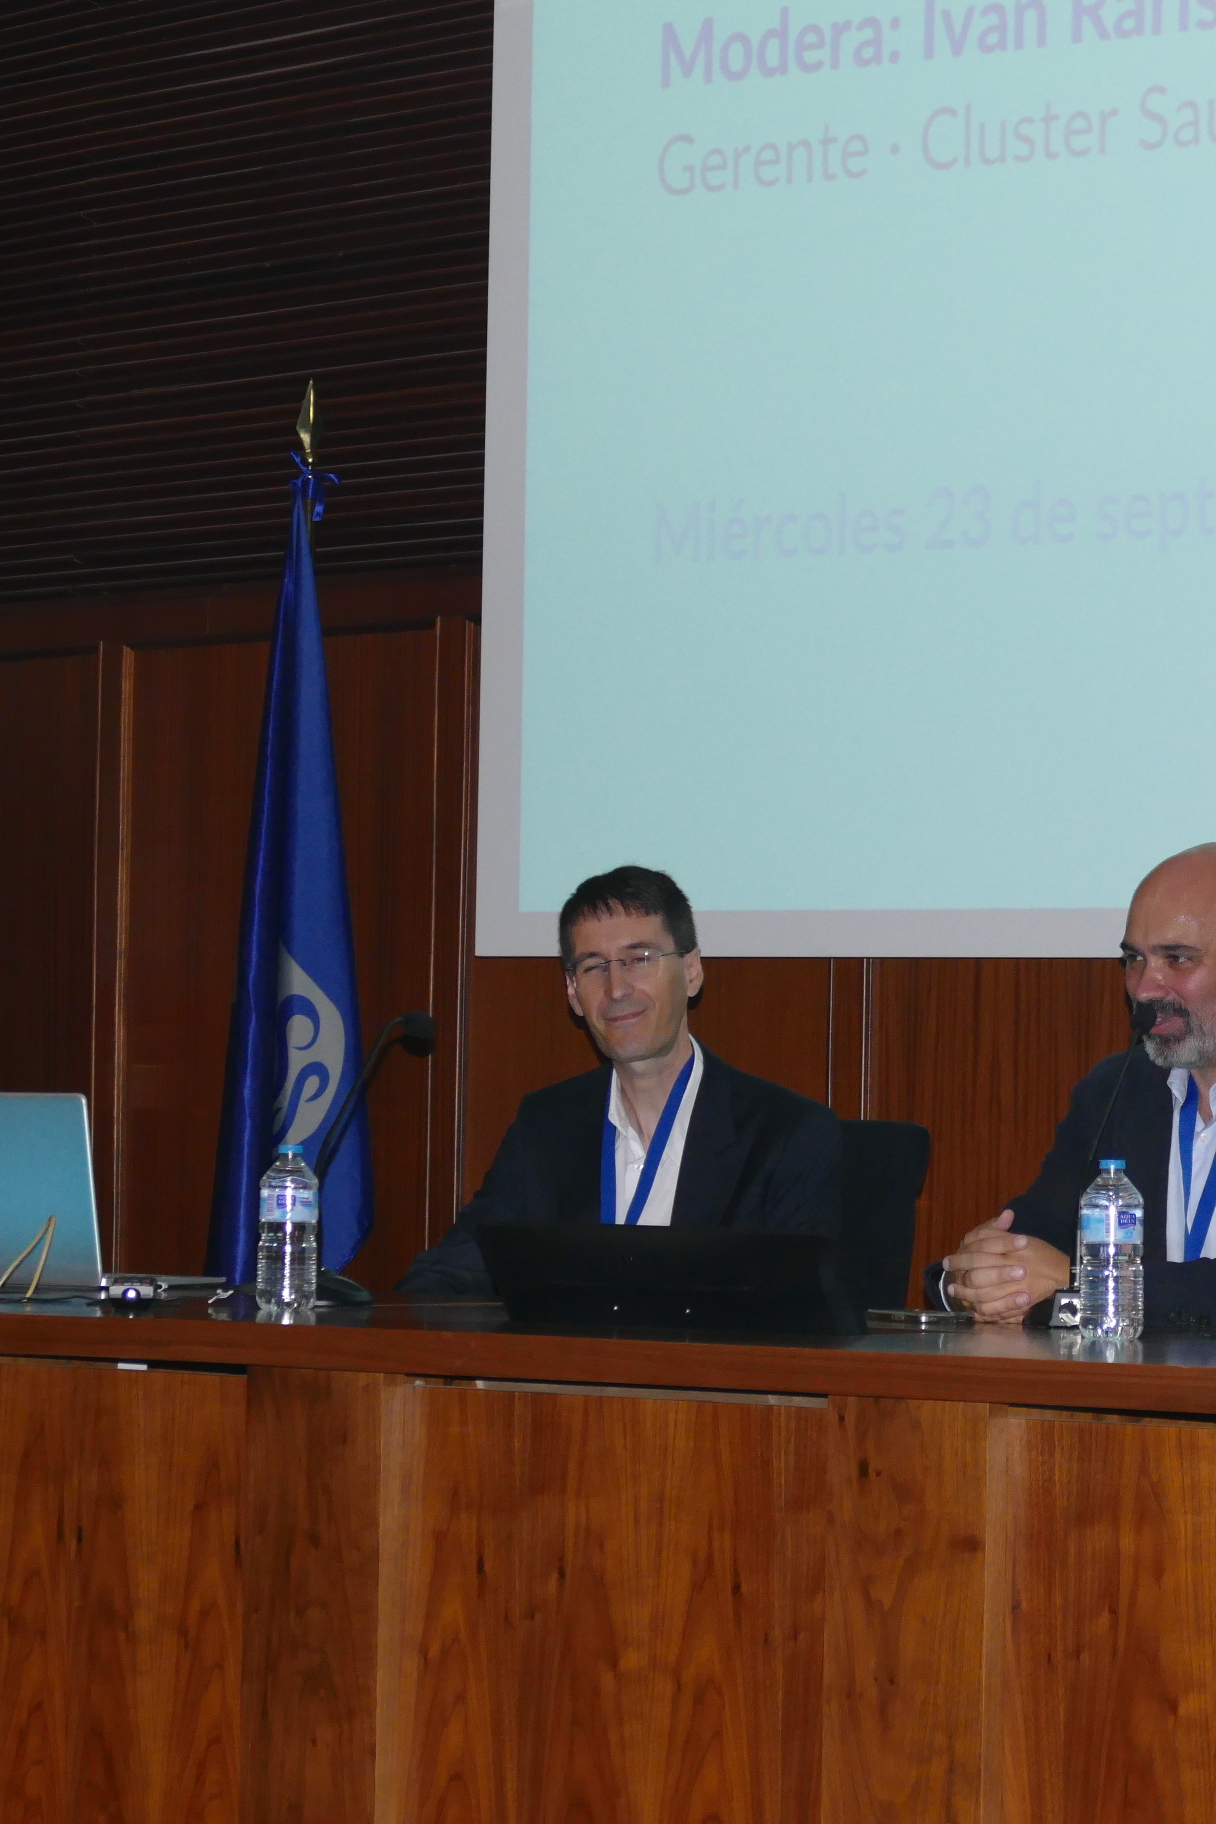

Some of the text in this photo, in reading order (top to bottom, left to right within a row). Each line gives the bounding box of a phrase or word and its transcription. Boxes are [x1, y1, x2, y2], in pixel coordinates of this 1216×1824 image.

[660, 6, 901, 89] Modera:
[657, 124, 870, 197] Gerente
[920, 103, 1120, 171] Cluster
[653, 492, 908, 565] Miércoles
[923, 484, 994, 551] 23
[1010, 480, 1078, 546] de
